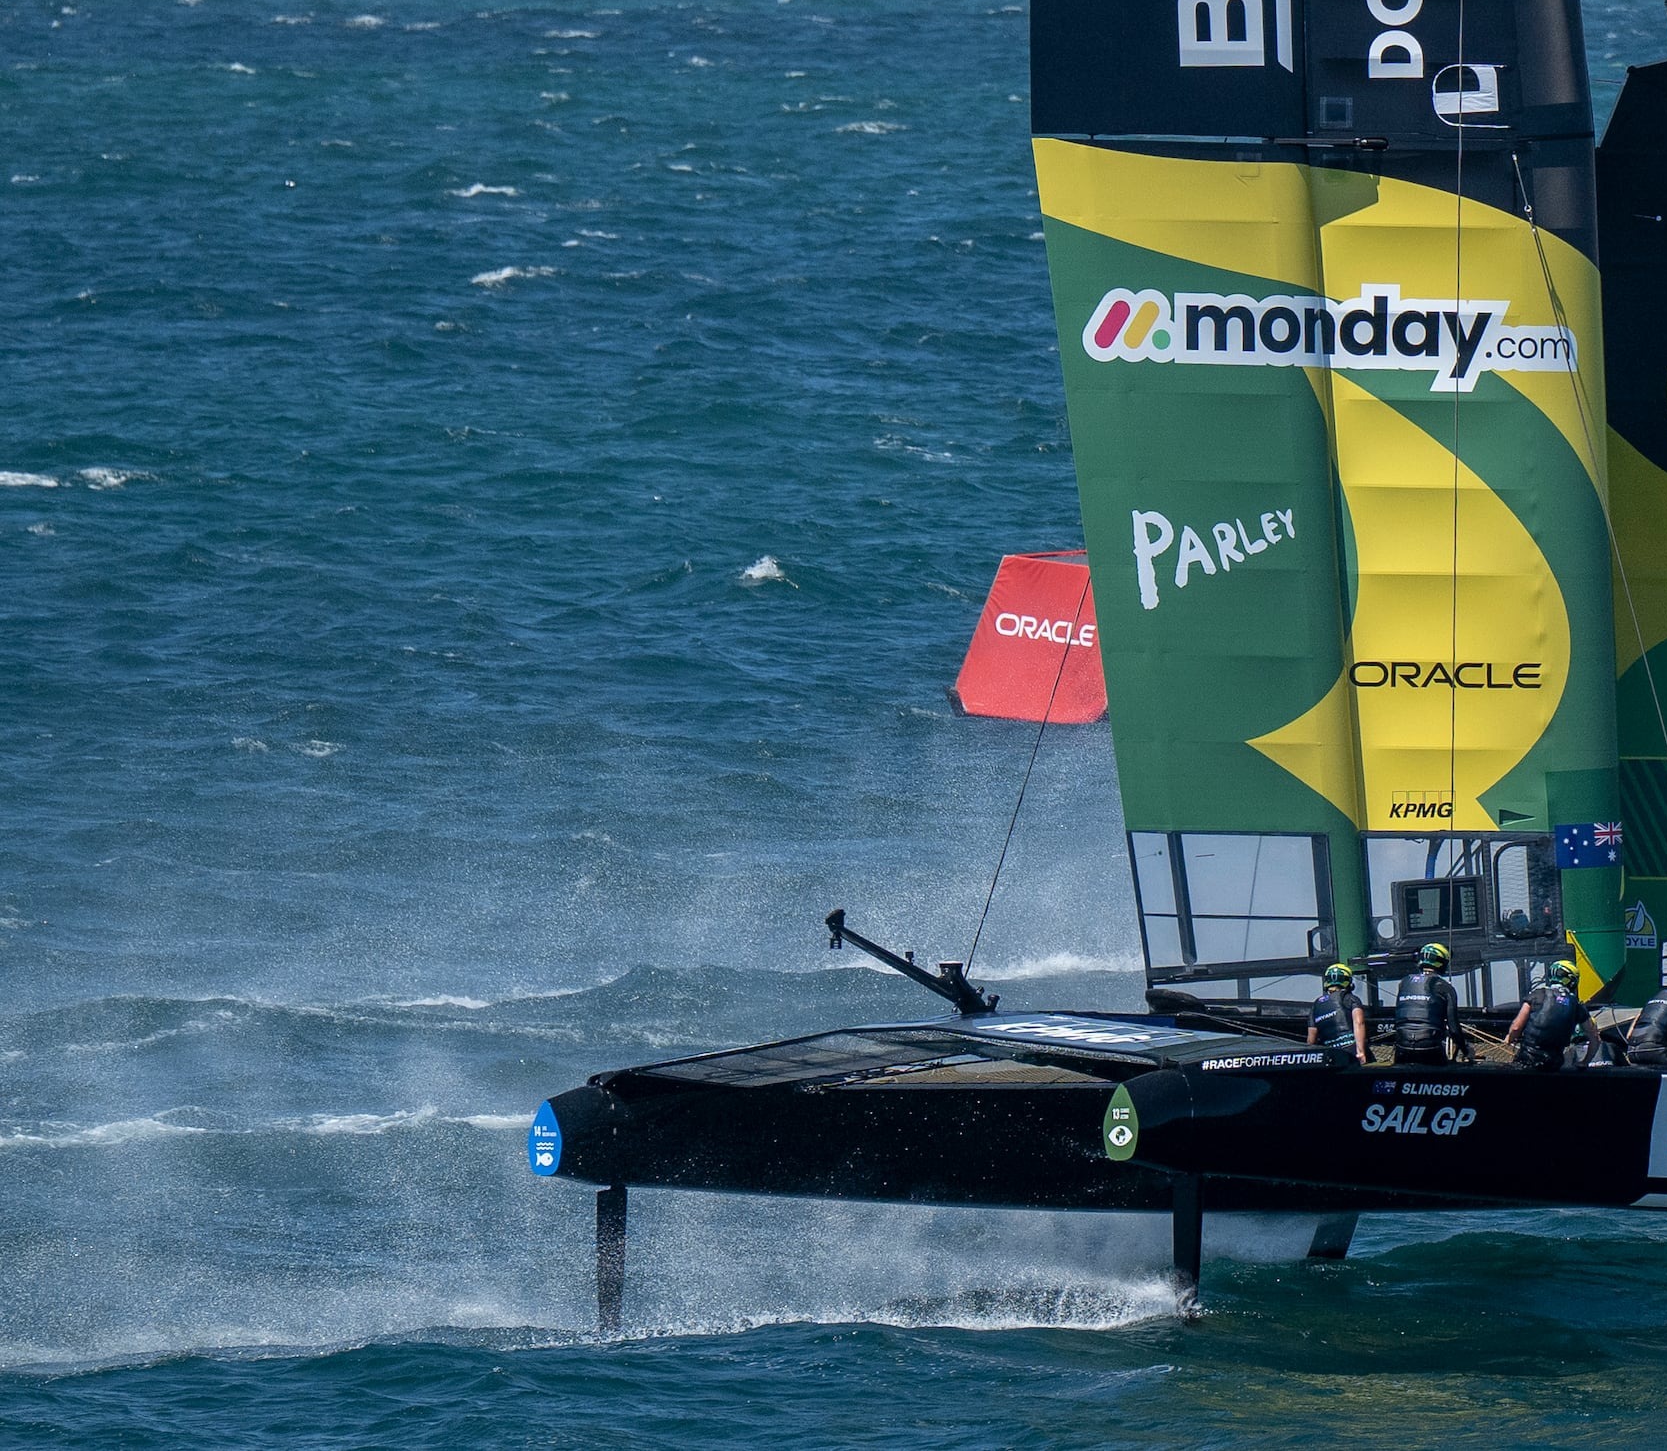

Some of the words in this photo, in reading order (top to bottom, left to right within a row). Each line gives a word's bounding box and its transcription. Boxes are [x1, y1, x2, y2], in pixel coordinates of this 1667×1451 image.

[1185, 295, 1572, 380] monday.com
[1132, 507, 1296, 610] PARLEY
[995, 613, 1096, 647] ORACLE
[1349, 661, 1543, 689] ORACLE
[1388, 802, 1454, 819] KPMG
[1626, 938, 1656, 947] OYLE
[1202, 1053, 1324, 1070] #RACEFORTHEFUTURE
[1402, 1083, 1469, 1096] SLINGSBY
